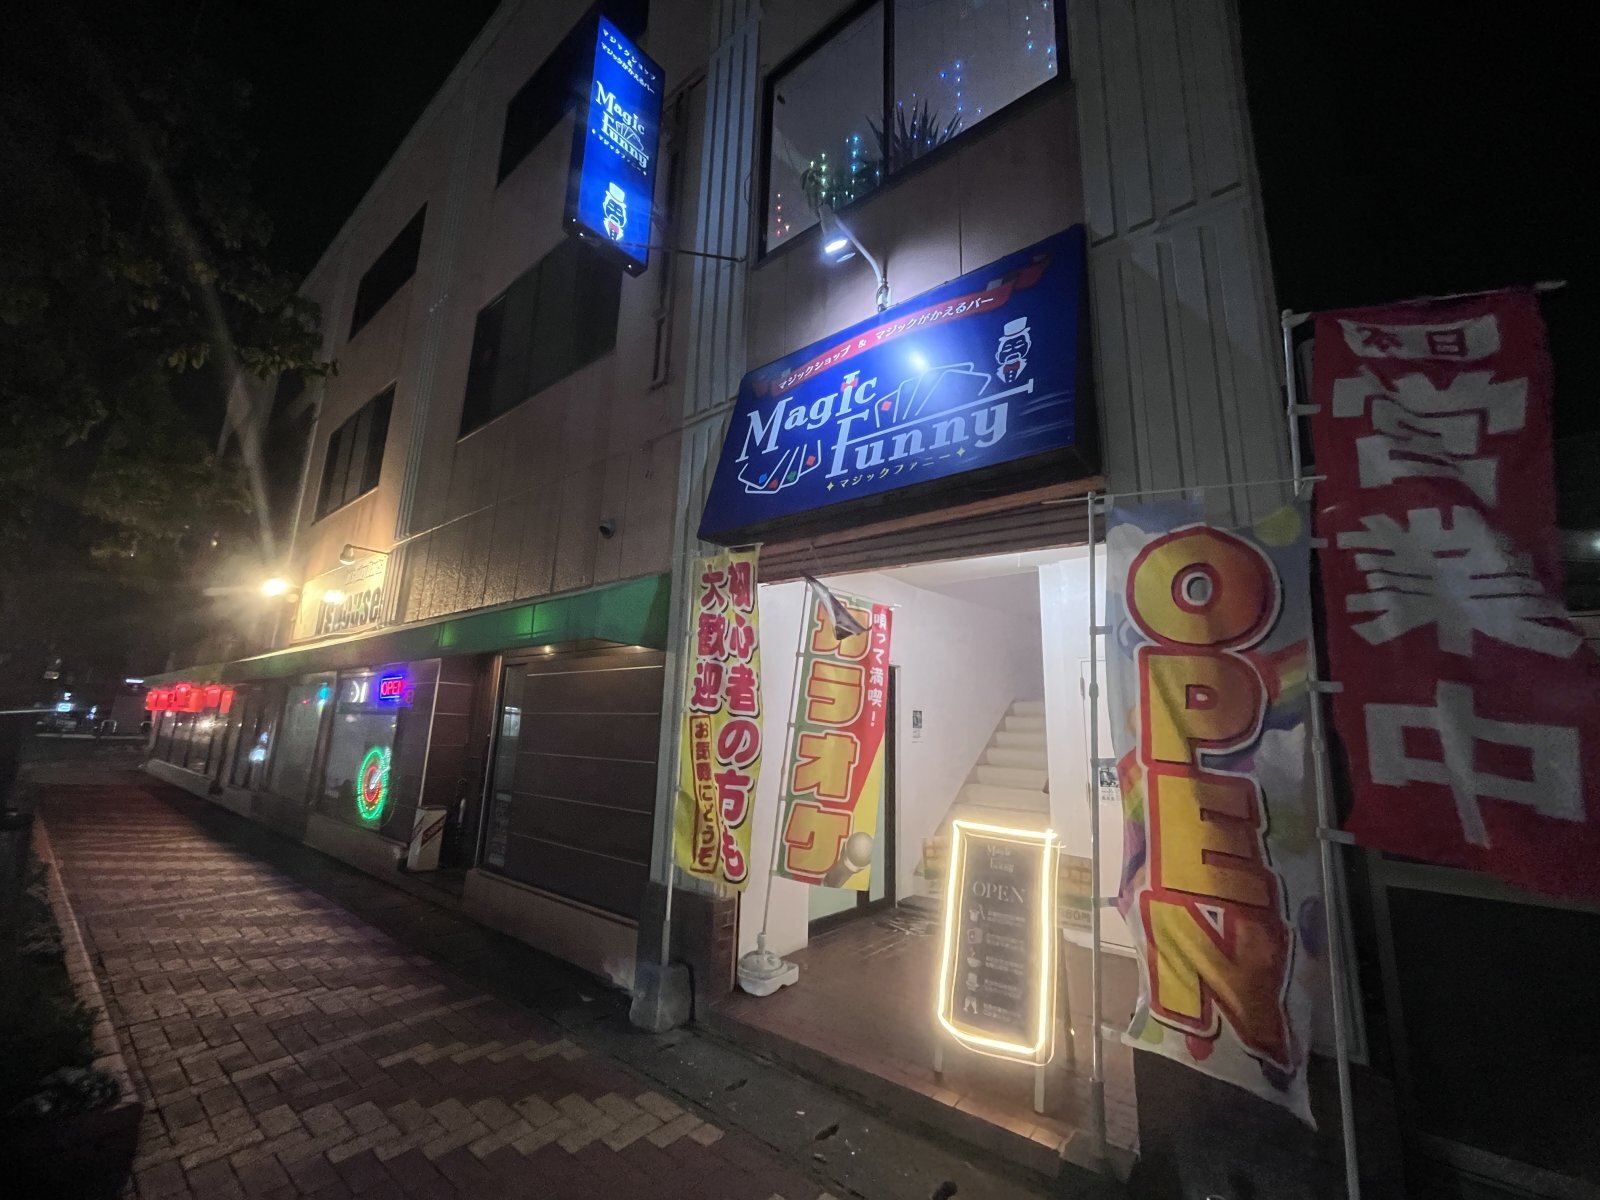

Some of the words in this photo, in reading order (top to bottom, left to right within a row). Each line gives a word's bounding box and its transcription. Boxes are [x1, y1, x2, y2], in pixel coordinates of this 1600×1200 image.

[595, 80, 646, 135] Magic
[601, 110, 650, 169] Funny
[777, 345, 852, 391] マジックショップ
[857, 338, 868, 349] &
[874, 295, 995, 341] マジックがかえるバー
[1357, 325, 1469, 357] 本日
[735, 370, 878, 464] Magic
[825, 378, 1034, 480] Funny
[838, 454, 950, 489] マジックファニー
[690, 563, 726, 711] 大歓迎
[1332, 365, 1586, 849] 営業中
[785, 600, 872, 875] カラオケ
[1126, 522, 1294, 1072] OPEN
[972, 880, 1026, 904] OPEN
